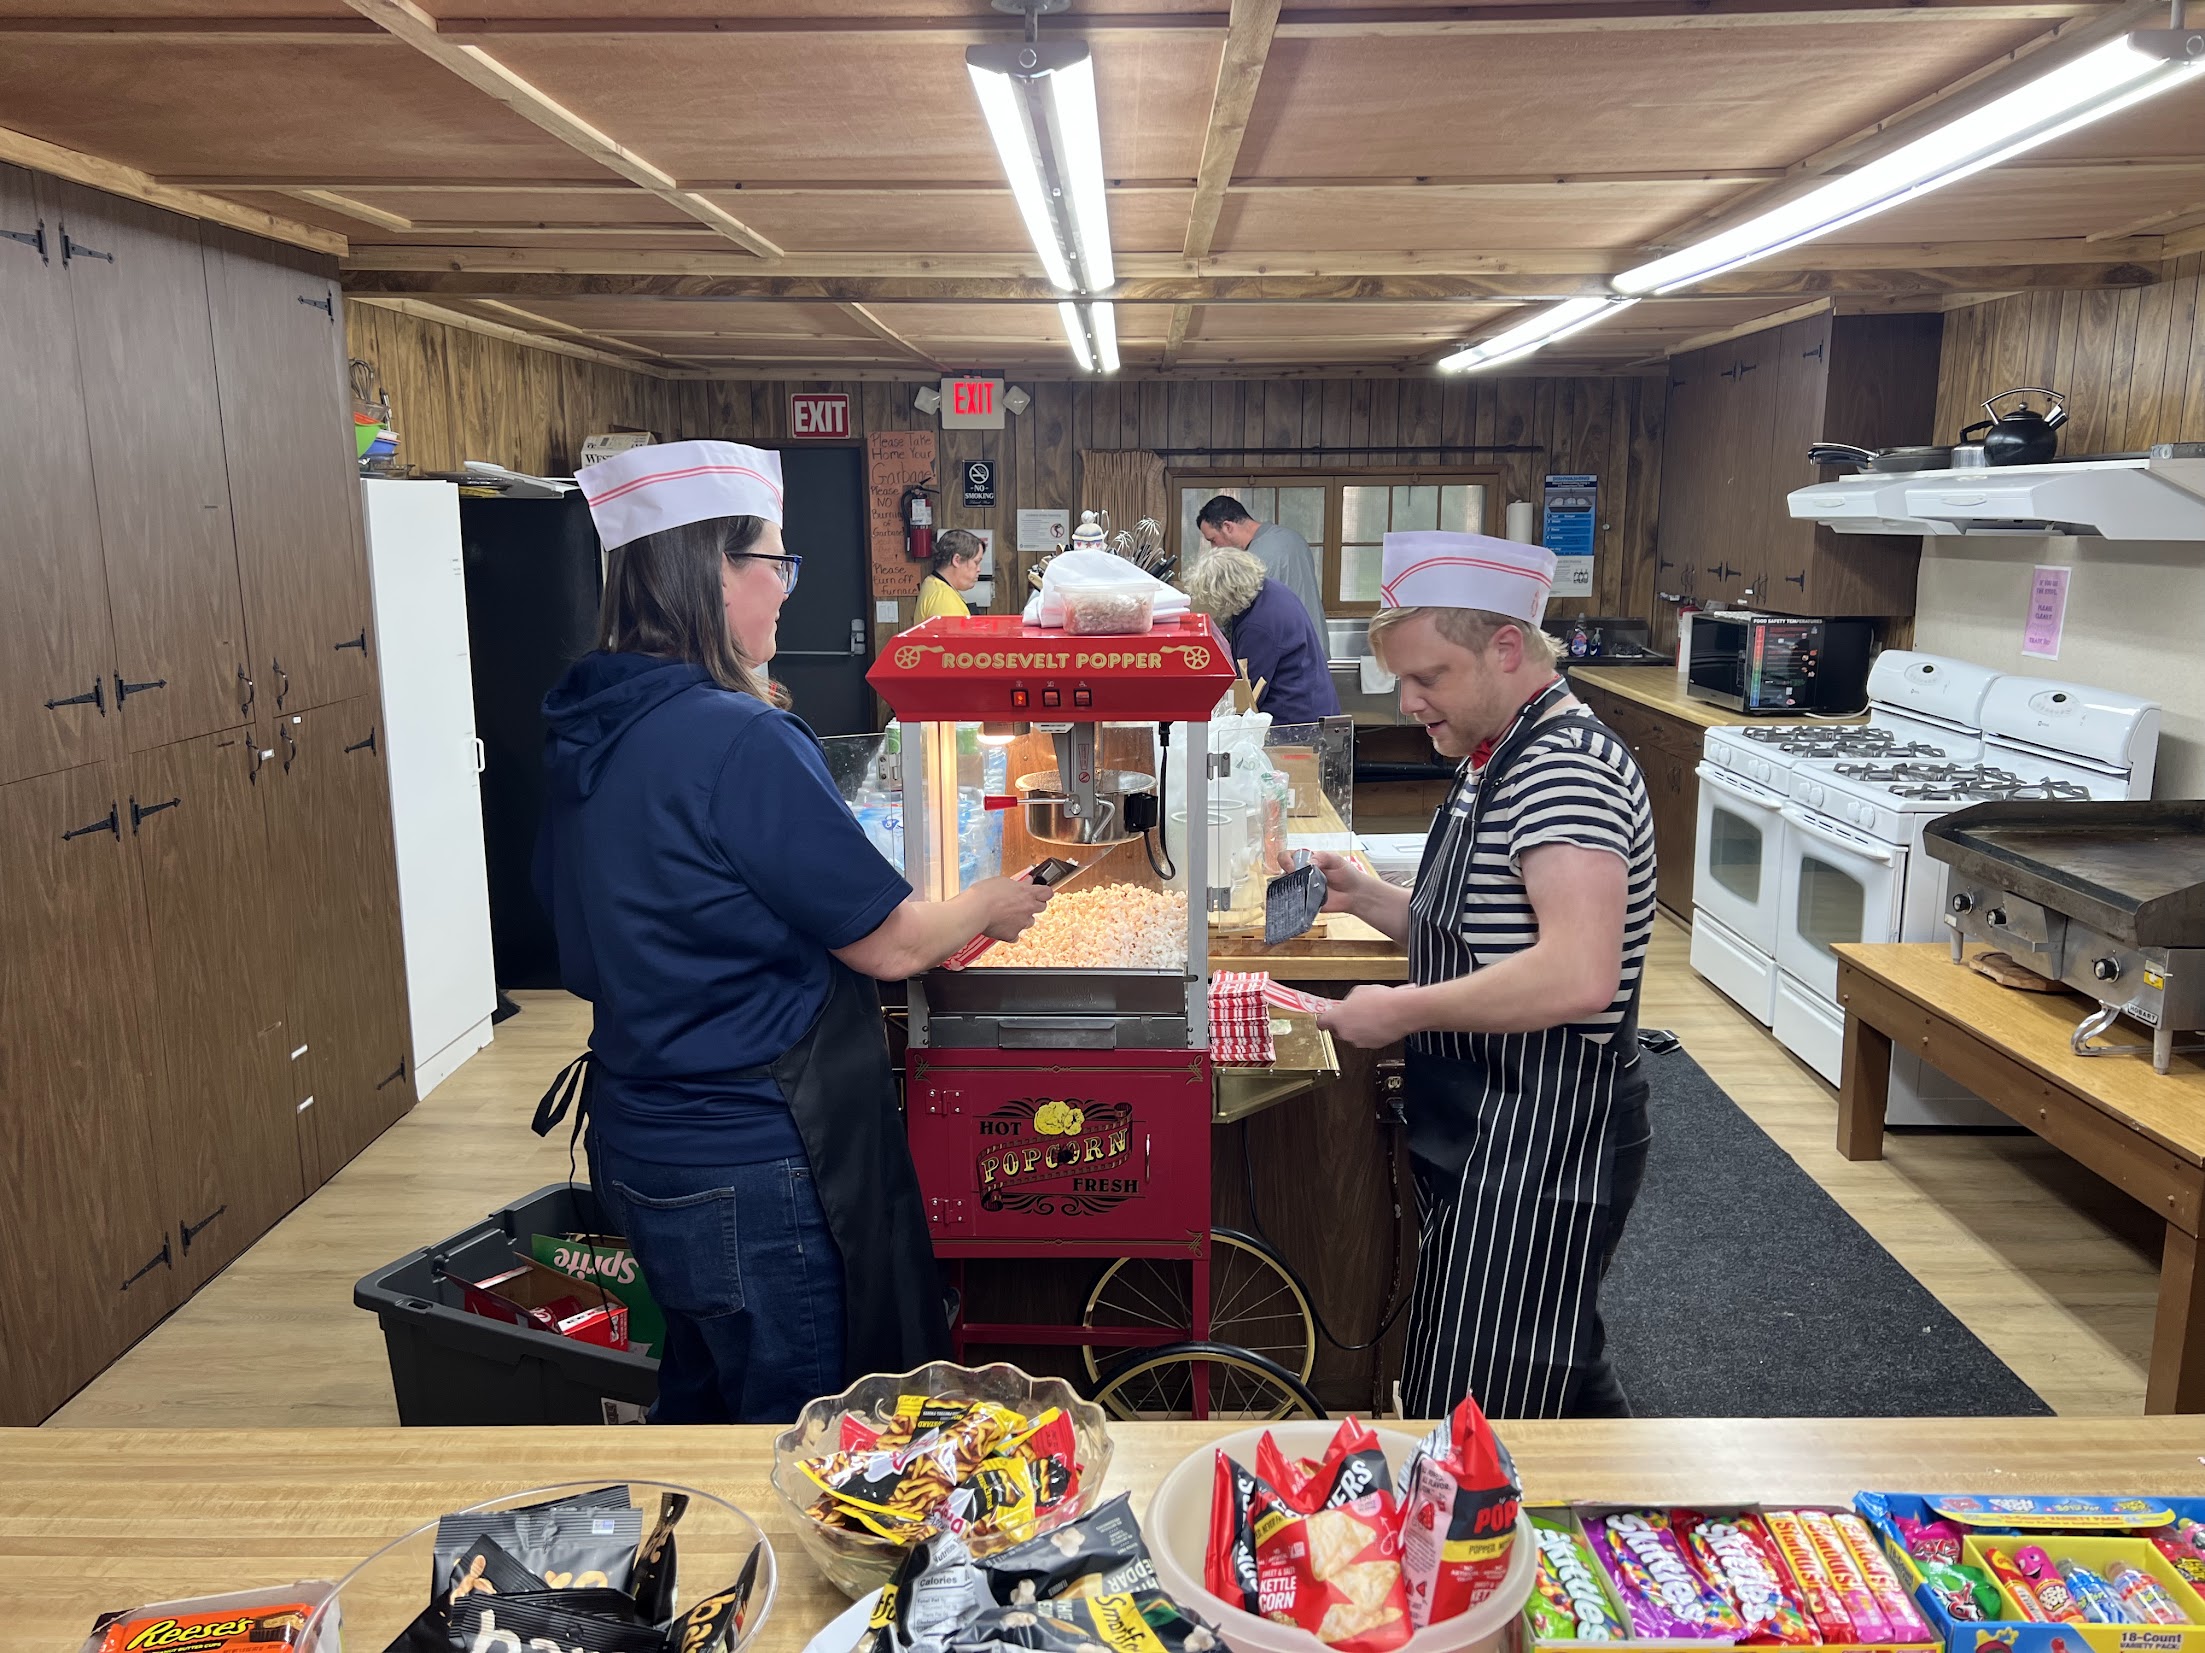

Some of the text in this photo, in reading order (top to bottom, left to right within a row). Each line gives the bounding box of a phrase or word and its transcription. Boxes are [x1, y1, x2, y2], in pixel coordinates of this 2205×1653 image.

[954, 382, 995, 415] EXIT
[794, 400, 846, 433] EXIT
[870, 431, 931, 447] Please Take
[871, 447, 933, 460] Home Your
[870, 485, 900, 496] Please
[964, 492, 994, 500] SMOKING
[973, 484, 985, 492] NO
[877, 497, 893, 508] NO
[873, 562, 907, 575] Please
[873, 574, 914, 585] turn off
[941, 652, 1162, 669] ROOSEVELT POPPER
[2130, 1005, 2157, 1021] HOBART
[980, 1121, 1022, 1136] HOT
[981, 1128, 1128, 1184] POPCORN
[1073, 1178, 1139, 1193] FRESH
[553, 1248, 639, 1284] Sprite
[1605, 1513, 1706, 1622] Skittles
[1694, 1523, 1777, 1624] Skittles
[919, 1575, 958, 1588] Calories
[1260, 1576, 1297, 1593] KETTLE
[1533, 1528, 1610, 1642] Skittles
[1258, 1591, 1296, 1613] CORN
[126, 1617, 254, 1651] Reese's
[2121, 1632, 2182, 1643] 18-Count
[178, 1644, 203, 1653] BUTTER
